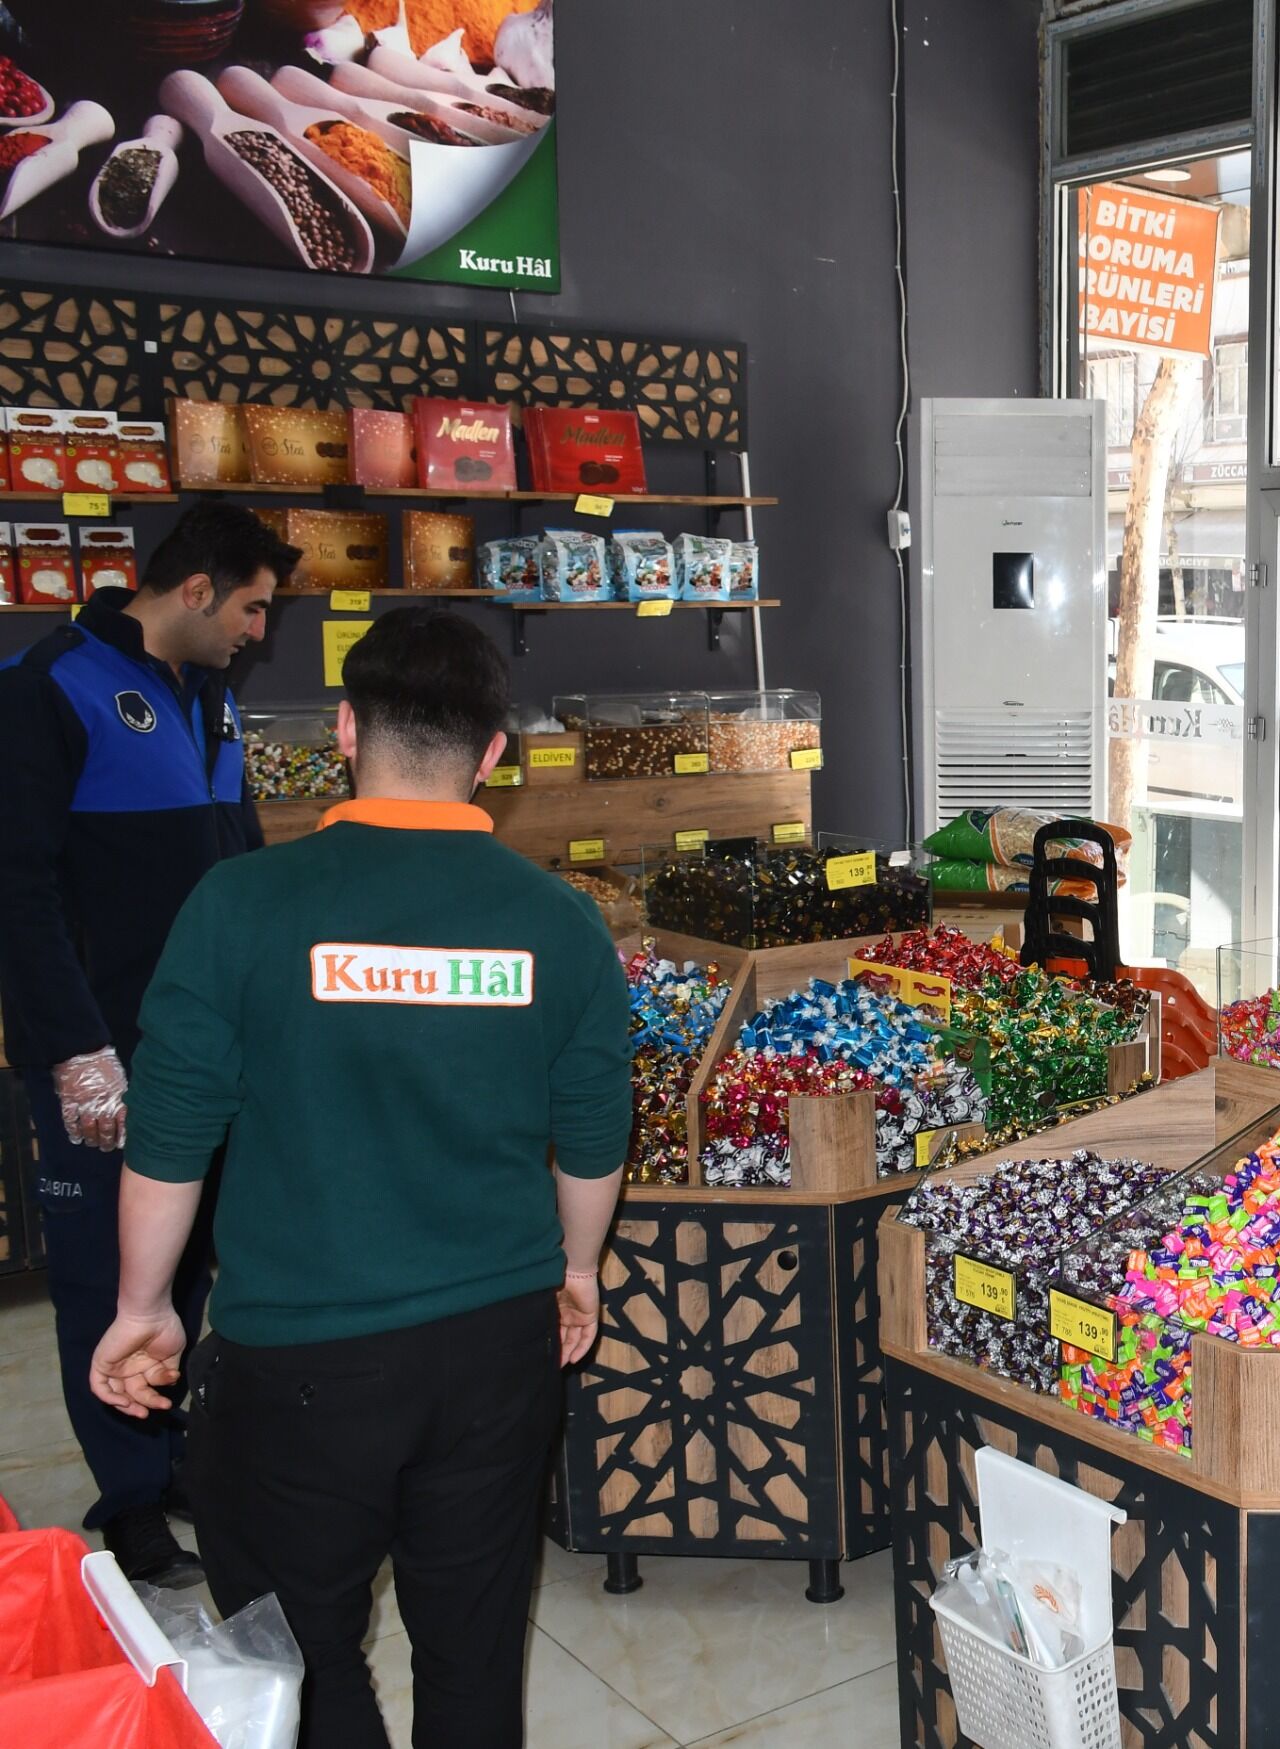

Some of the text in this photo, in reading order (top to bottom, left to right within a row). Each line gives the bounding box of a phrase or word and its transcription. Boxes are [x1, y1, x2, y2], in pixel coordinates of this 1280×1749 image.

[1096, 198, 1176, 239] BİTKİ
[459, 249, 552, 278] Kuru Hâl
[1079, 265, 1205, 314] RÜNLERİ
[1079, 304, 1176, 343] BAYİSİ
[436, 417, 500, 444] Madlen
[560, 425, 625, 447] Madlen
[1211, 464, 1247, 478] ZÜCCA
[532, 750, 572, 763] ELDİVEN
[849, 867, 865, 877] 139
[321, 954, 526, 997] Kuru Hâl
[981, 1282, 998, 1300] 139
[1078, 1321, 1098, 1340] 139
